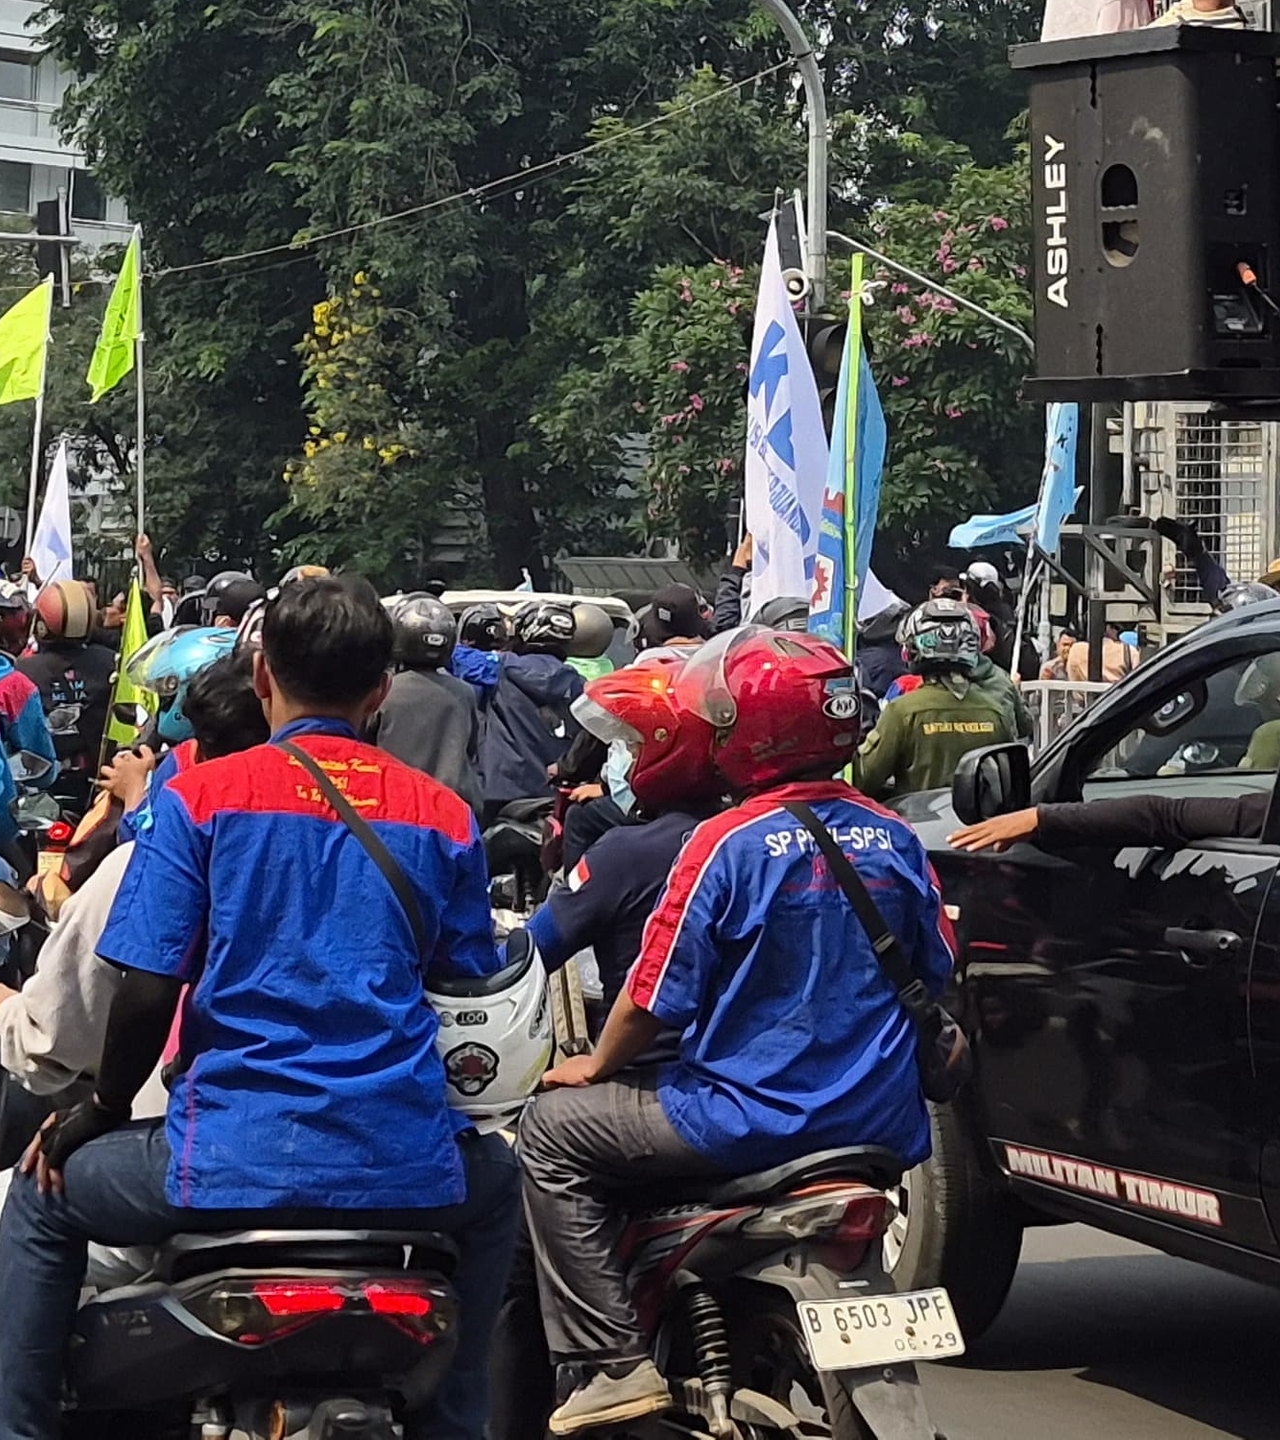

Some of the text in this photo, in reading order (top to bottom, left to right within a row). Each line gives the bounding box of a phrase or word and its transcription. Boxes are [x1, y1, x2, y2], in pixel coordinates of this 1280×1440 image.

[1044, 134, 1069, 309] ASHLEY
[764, 830, 793, 857] SP
[1007, 1146, 1221, 1224] MILITAN TIMUR
[806, 1294, 947, 1333] B 6503 JPF
